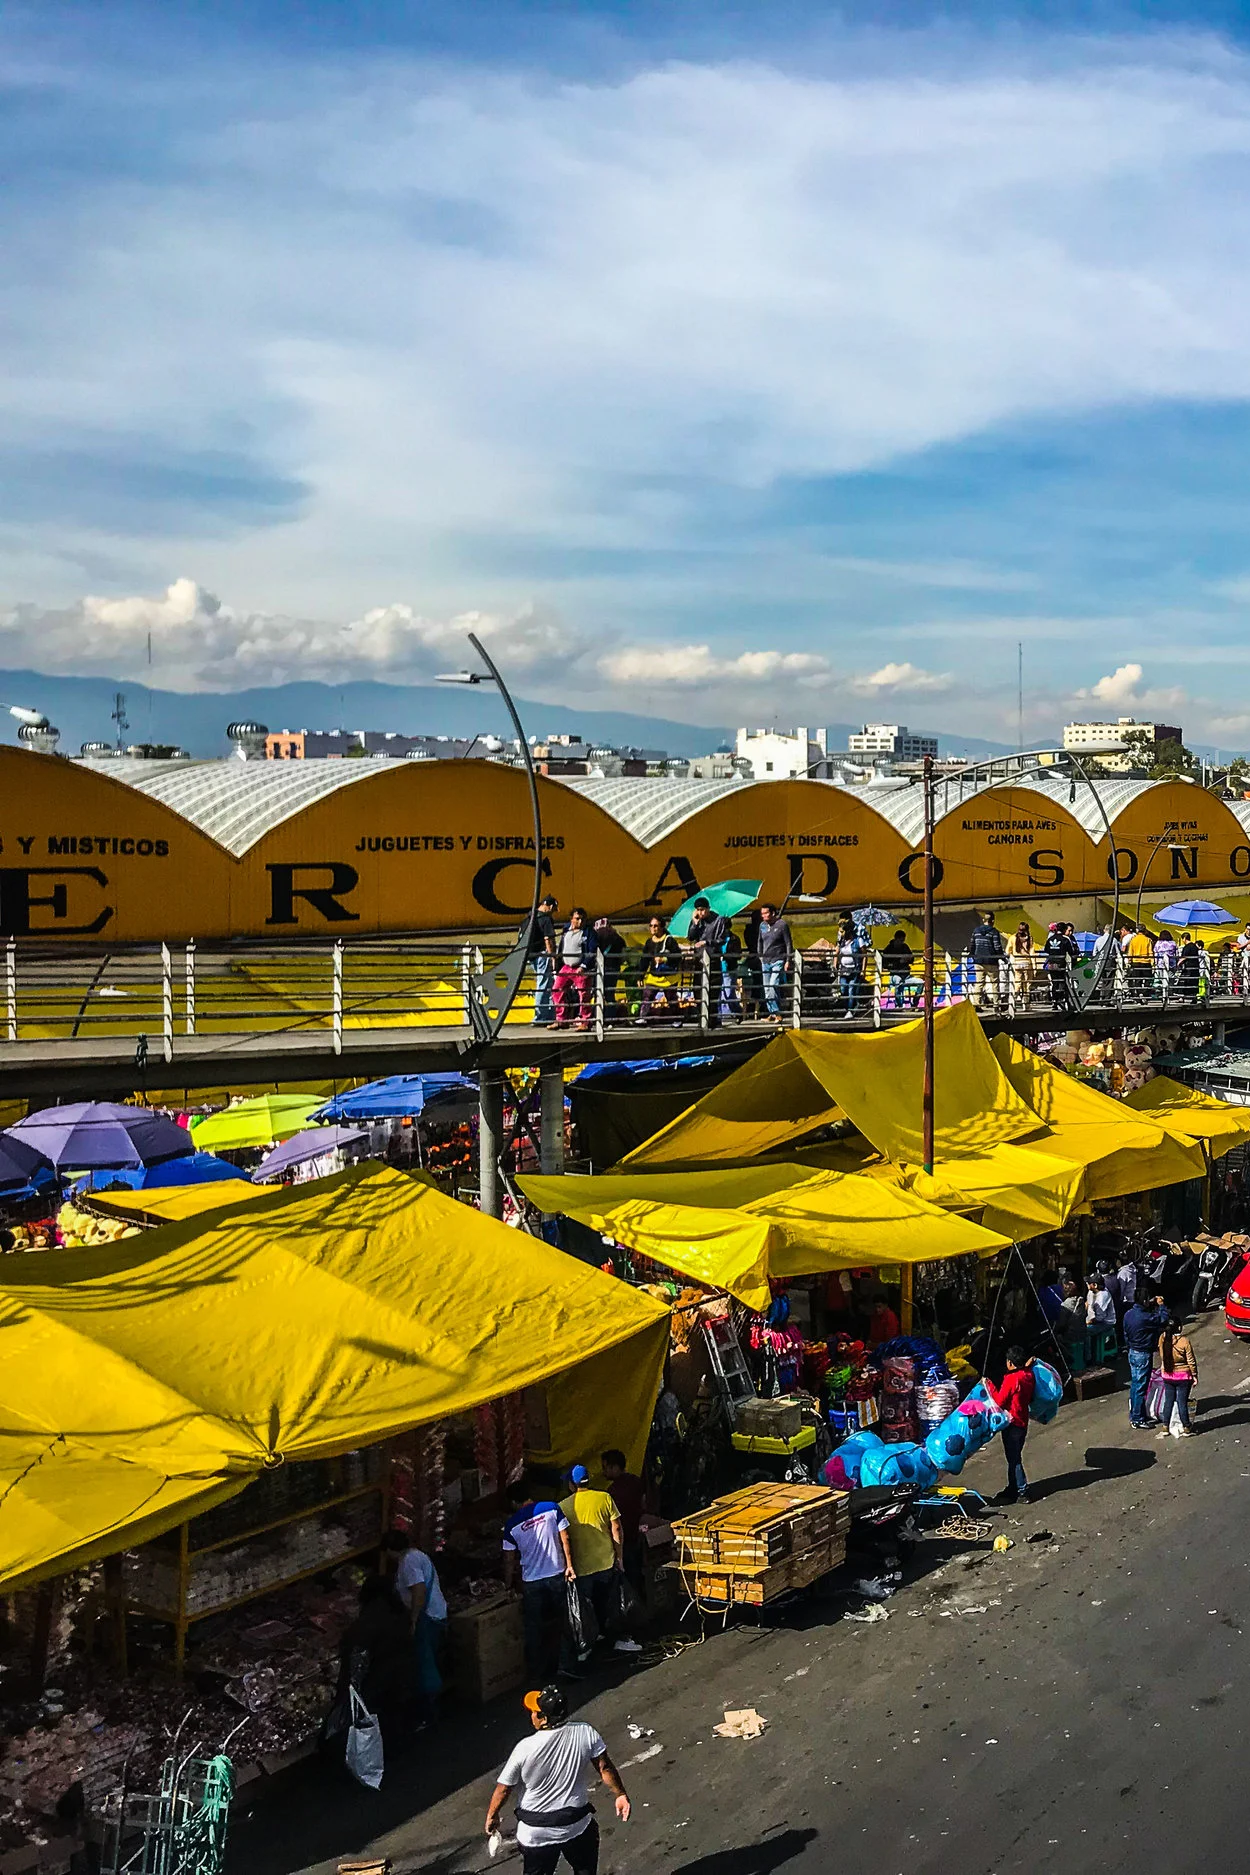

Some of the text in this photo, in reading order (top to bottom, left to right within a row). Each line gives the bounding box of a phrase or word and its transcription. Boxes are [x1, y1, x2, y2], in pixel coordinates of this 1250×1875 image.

[962, 820, 1057, 831] ALIMENTOS PARA AVES
[17, 836, 35, 855] Y
[48, 836, 170, 857] MISTICOS
[355, 836, 454, 852] JUGUETES
[459, 836, 472, 851] Y
[724, 834, 859, 848] JUGUETES Y DISFRACES
[988, 834, 1034, 845] CANORAS
